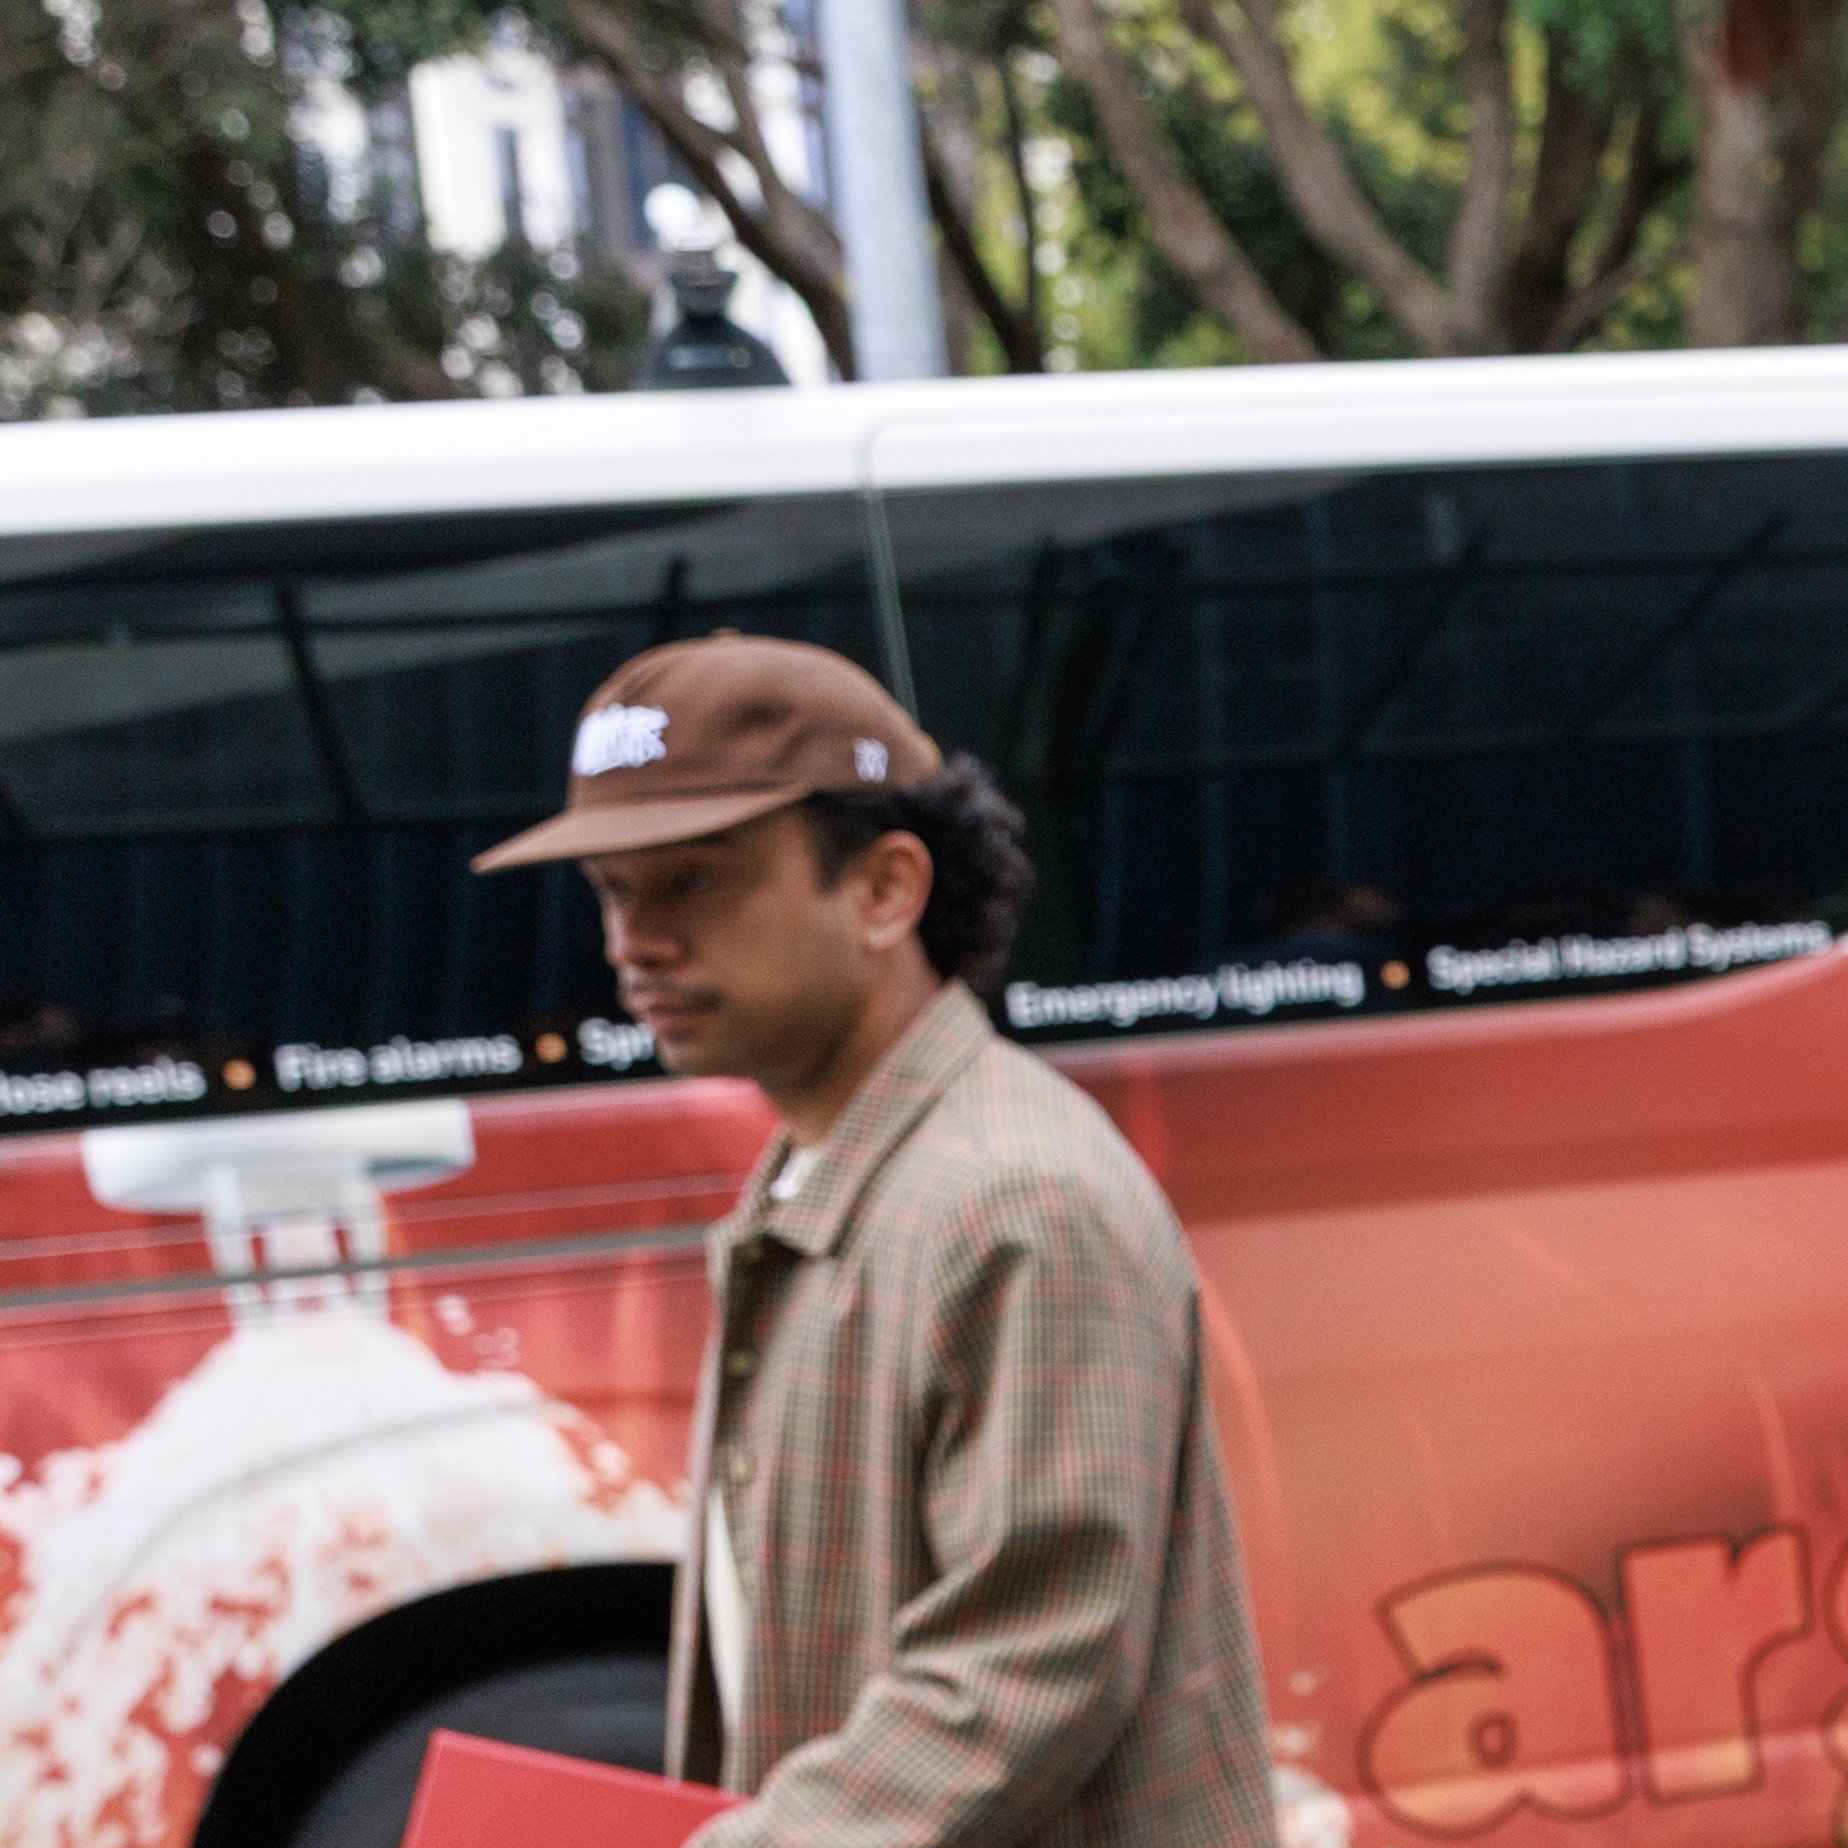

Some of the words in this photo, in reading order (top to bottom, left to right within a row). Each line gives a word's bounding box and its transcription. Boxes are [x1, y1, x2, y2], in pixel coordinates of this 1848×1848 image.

[86, 1055, 207, 1108] reels
[273, 1042, 368, 1093] Fire
[368, 1034, 525, 1084] alarms
[1005, 974, 1217, 1028] Emergency
[1216, 957, 1365, 1016] lighting
[1426, 937, 1560, 996] Special
[1559, 925, 1687, 978] Hazard
[1685, 919, 1832, 973] Systems
